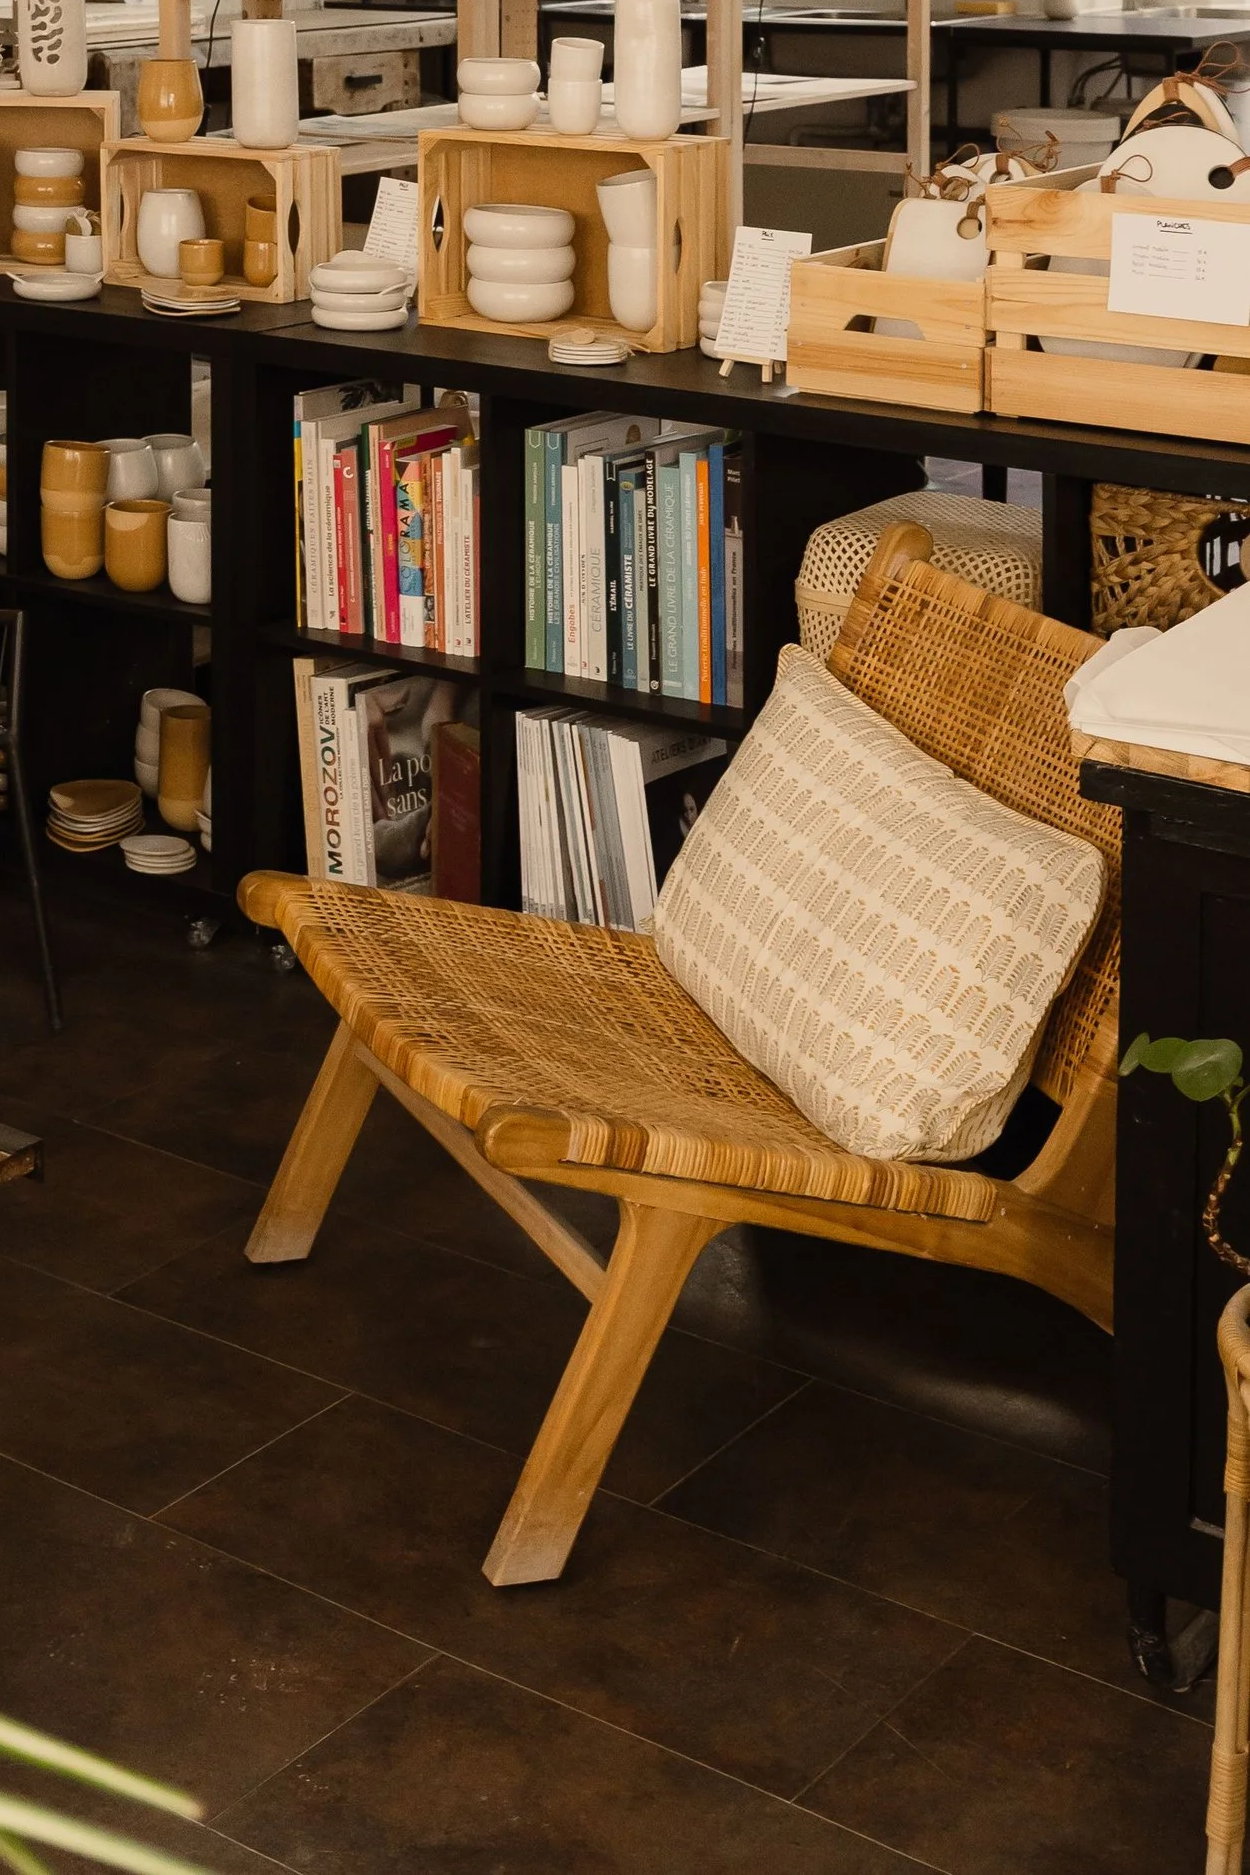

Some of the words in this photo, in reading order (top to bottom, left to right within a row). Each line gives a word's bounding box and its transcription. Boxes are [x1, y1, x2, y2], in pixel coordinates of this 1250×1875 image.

[306, 459, 314, 485] MAIN
[324, 485, 332, 531] céramique
[648, 506, 657, 518] DU
[664, 483, 675, 548] CÉRAMIQUE
[325, 532, 332, 541] la
[399, 483, 411, 592] COLORAMA
[527, 520, 535, 563] CÉRAMIQUE
[647, 520, 655, 543] LIVRE
[325, 542, 333, 553] de
[463, 535, 471, 576] CÉRAMISTE
[666, 551, 675, 564] LA
[326, 554, 334, 583] science
[529, 565, 535, 574] LA
[648, 545, 656, 575] GRAND
[529, 576, 535, 586] DE
[548, 567, 553, 577] LA
[623, 554, 633, 609] CÉRAMISTE
[649, 575, 656, 587] LE
[666, 567, 676, 582] DE
[699, 566, 707, 584] Inde
[328, 584, 334, 597] La
[464, 577, 471, 588] DU
[548, 579, 553, 589] DE
[590, 547, 602, 633] CÉRAMIQUE
[700, 585, 707, 596] en
[666, 585, 676, 613] LIVRE
[568, 604, 577, 643] Engobes
[627, 611, 633, 621] DU
[700, 597, 708, 652] traditionnelle
[627, 642, 633, 650] LE
[667, 615, 677, 658] GRAND
[668, 660, 678, 672] LE
[700, 654, 708, 682] Poterie
[324, 715, 330, 725] DE
[378, 757, 403, 786] La
[319, 725, 343, 875] MOROZOV
[339, 791, 343, 800] LA
[386, 787, 428, 817] sans
